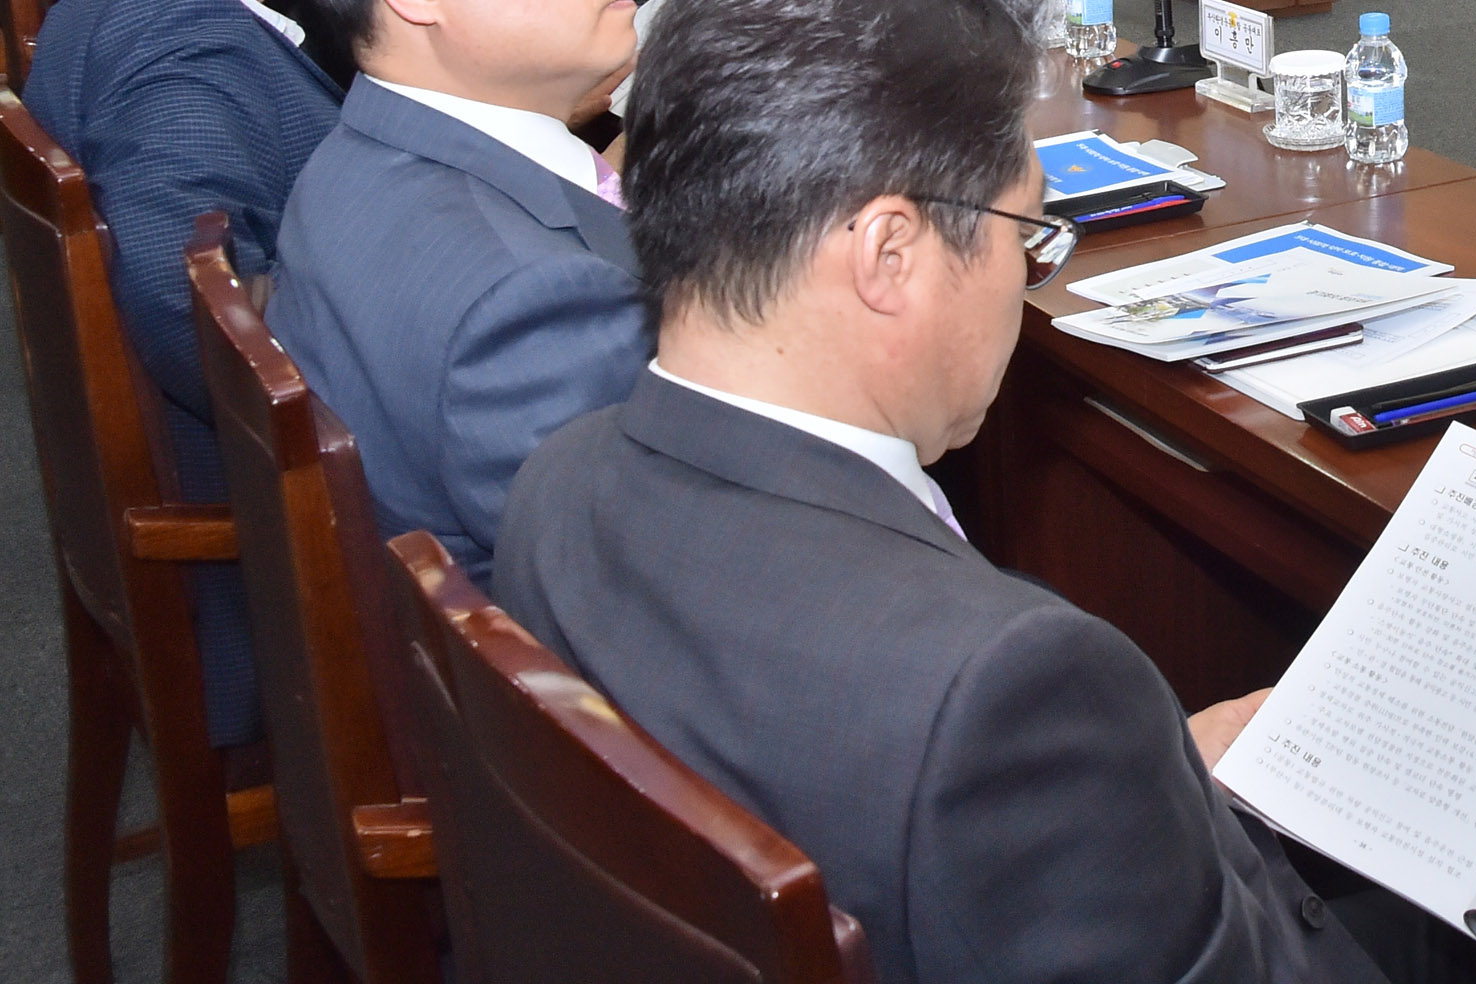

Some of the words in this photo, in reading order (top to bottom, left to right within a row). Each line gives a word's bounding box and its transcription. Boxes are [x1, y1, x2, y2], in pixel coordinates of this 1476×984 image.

[1409, 545, 1430, 562] 추진
[1429, 554, 1450, 571] 내용
[1279, 737, 1302, 756] 추진
[1301, 749, 1324, 769] 내용
